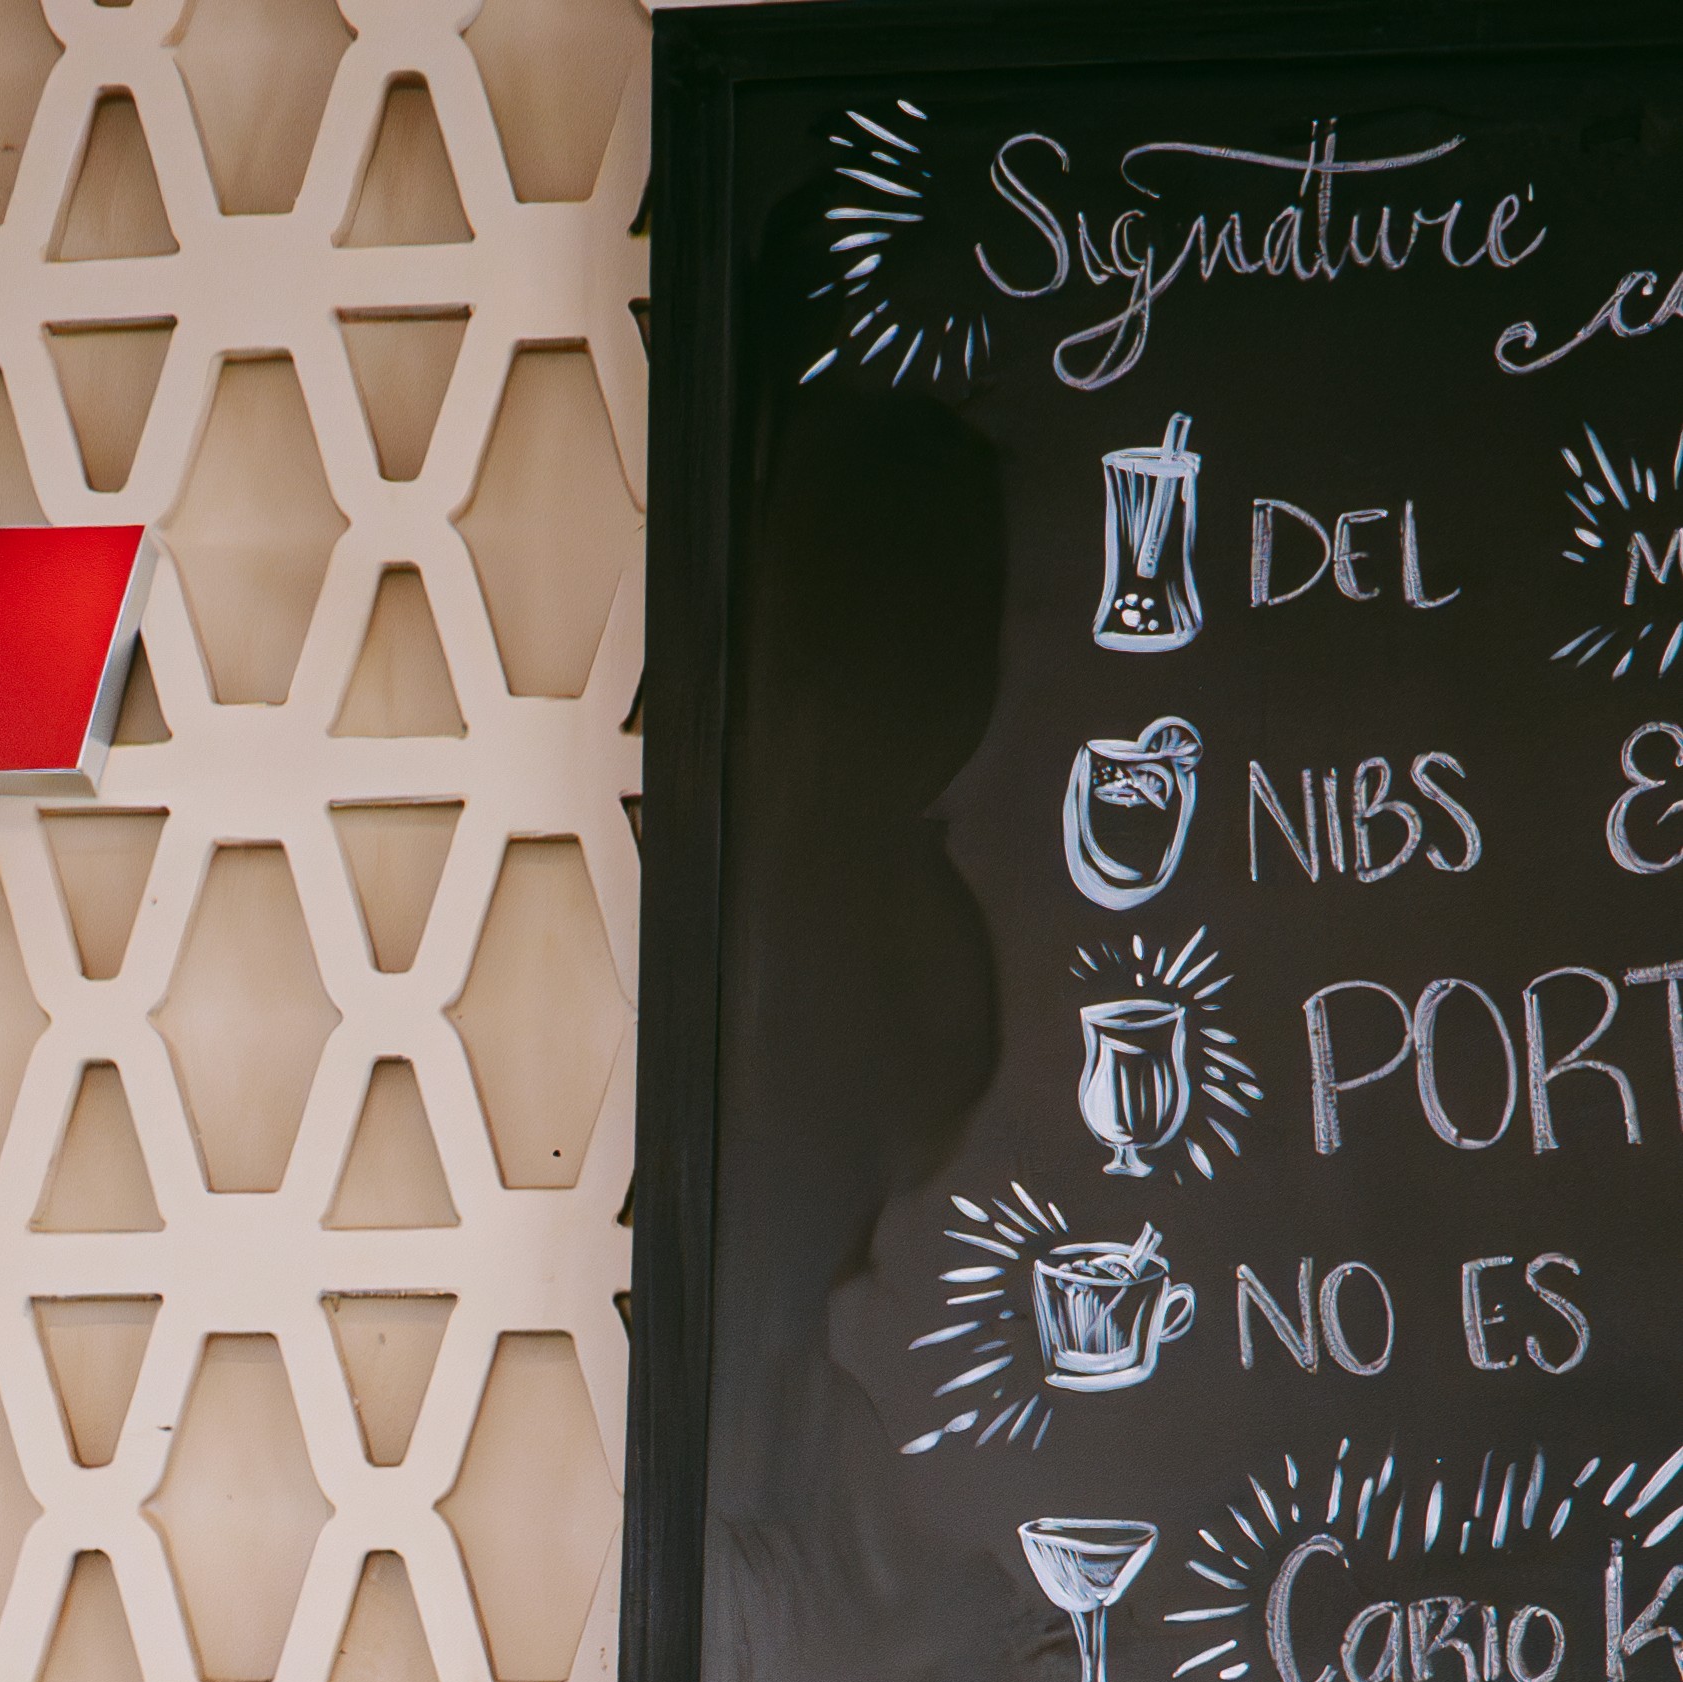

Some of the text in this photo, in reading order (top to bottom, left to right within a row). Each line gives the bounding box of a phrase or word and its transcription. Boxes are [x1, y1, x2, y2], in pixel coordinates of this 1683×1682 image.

[975, 118, 1547, 390] Signature
[1250, 498, 1461, 608] DEL
[1249, 751, 1482, 884] NIBS
[1235, 1252, 1591, 1377] NO ES
